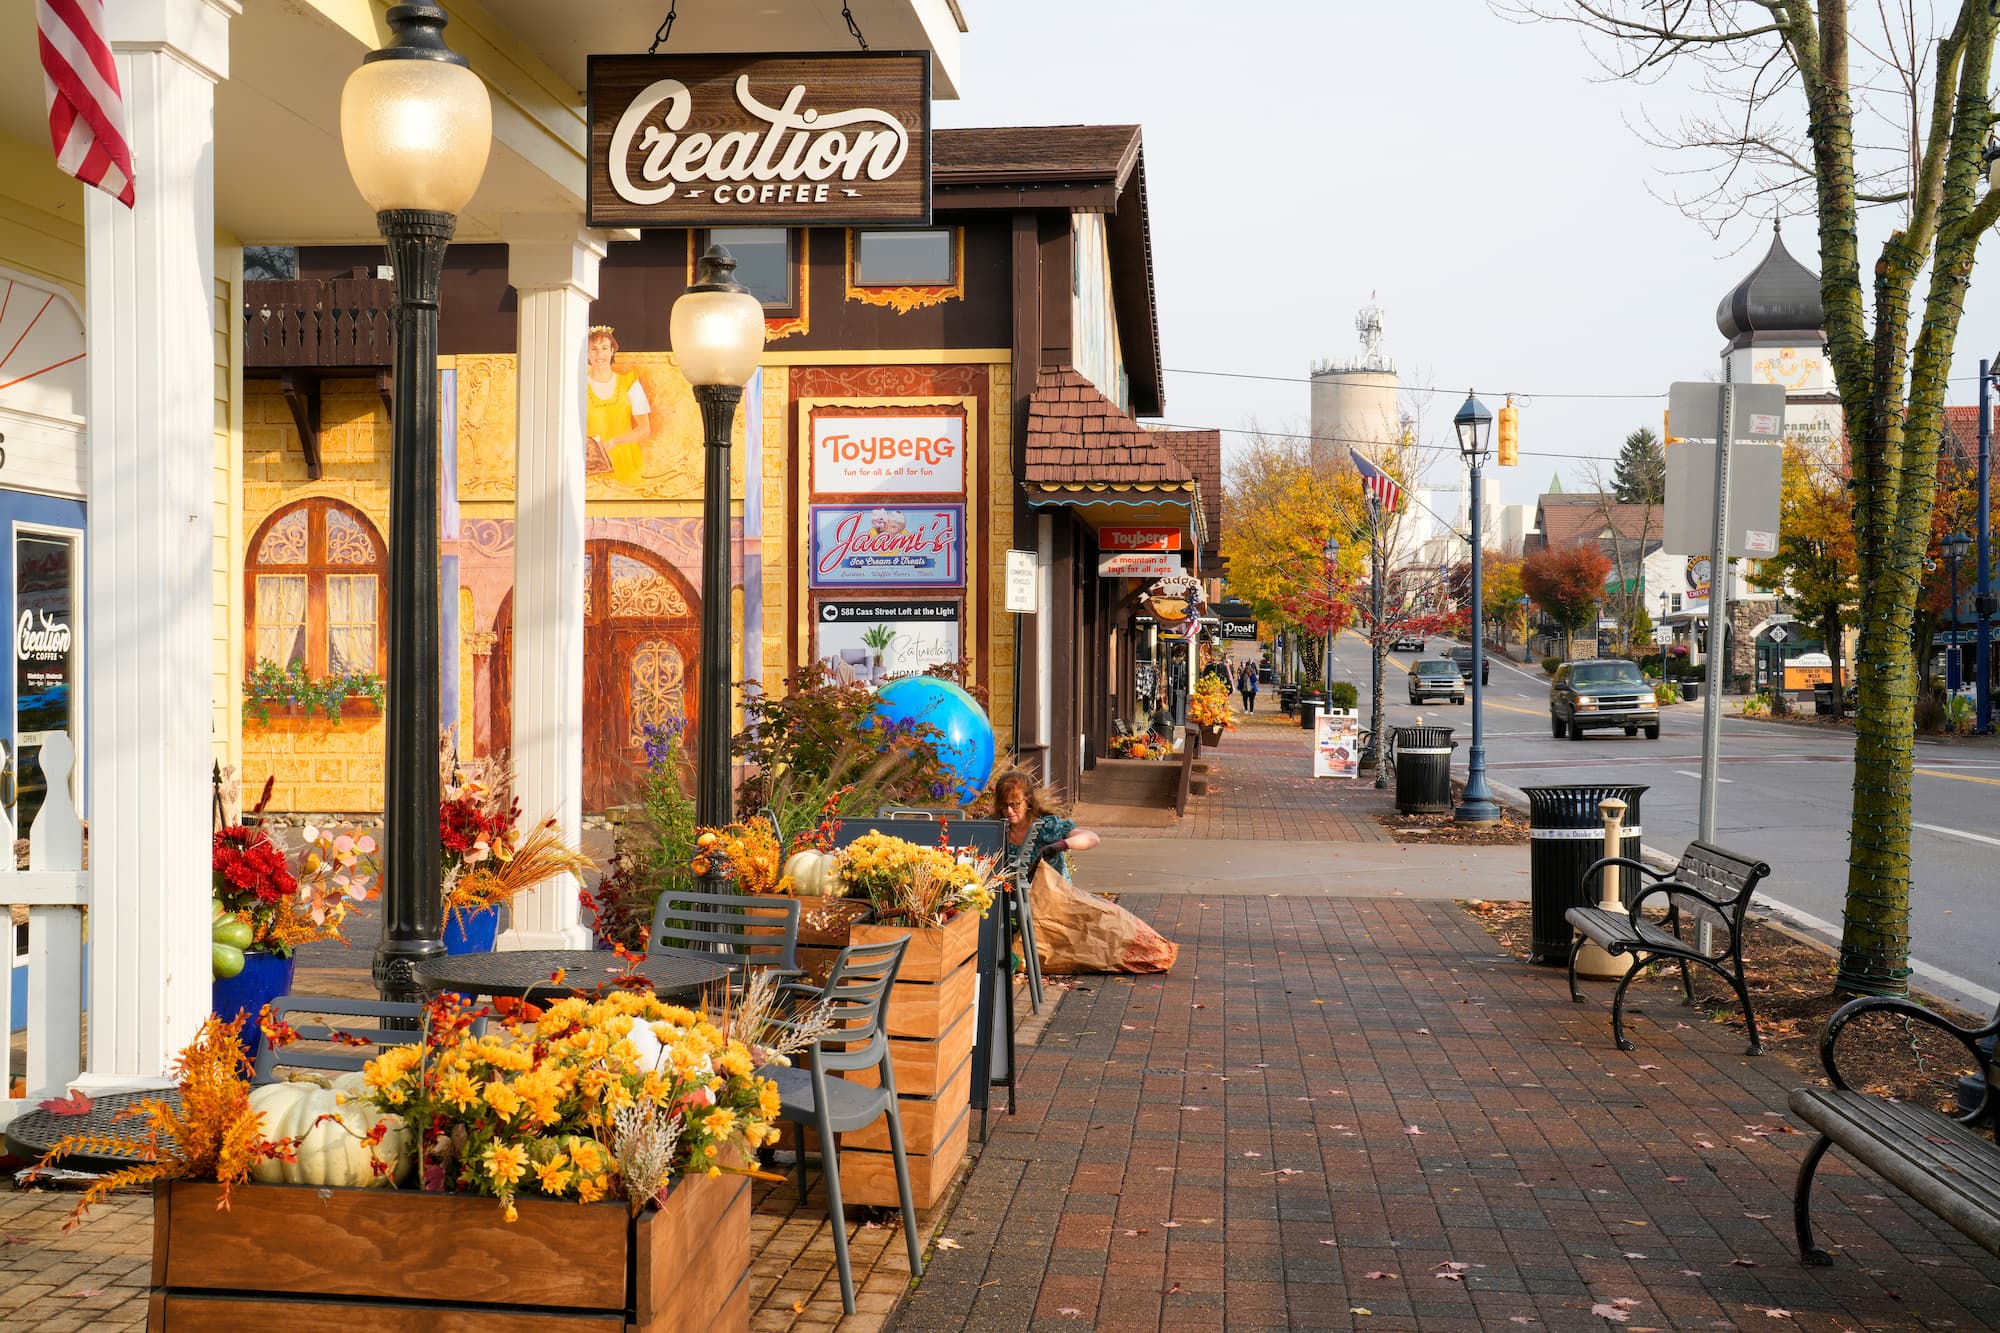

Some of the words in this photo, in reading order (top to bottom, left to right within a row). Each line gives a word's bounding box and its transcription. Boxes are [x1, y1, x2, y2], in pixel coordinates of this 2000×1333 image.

[608, 74, 908, 205] Creation
[713, 184, 829, 204] COFFEE
[1784, 420, 1830, 432] enmuth
[843, 468, 857, 476] fun
[860, 467, 871, 476] for
[873, 467, 882, 476] all
[885, 468, 892, 476] &
[894, 467, 904, 476] all
[906, 467, 918, 476] for
[920, 467, 933, 476] fun
[819, 511, 955, 574] Jaami's
[1112, 530, 1168, 549] Toyberg
[849, 556, 865, 566] Ice
[865, 556, 891, 565] Cream
[893, 557, 899, 565] &
[900, 556, 926, 565] Treats
[1120, 557, 1156, 566] mountain
[1159, 555, 1168, 564] of
[1108, 566, 1125, 575] toys
[1128, 565, 1138, 573] for
[1142, 565, 1151, 573] all
[1153, 567, 1171, 575] ages
[841, 608, 854, 616] 588
[856, 608, 873, 616] Cass
[875, 608, 897, 616] Street
[898, 608, 912, 616] Left
[914, 608, 921, 616] at
[923, 608, 935, 616] the
[936, 608, 955, 617] Light
[18, 608, 71, 660] Creation
[1659, 635, 1671, 643] 30
[891, 632, 953, 666] Saturday
[36, 652, 57, 660] COFFEE
